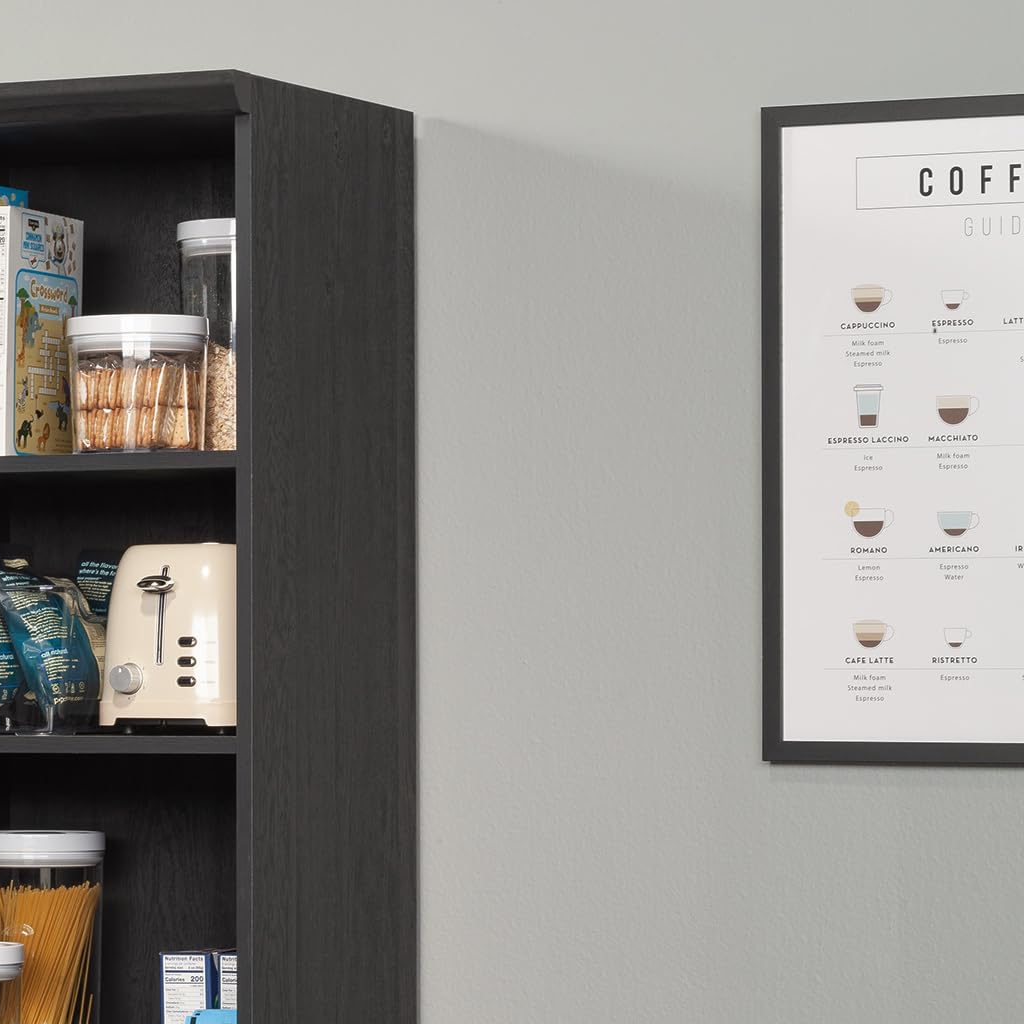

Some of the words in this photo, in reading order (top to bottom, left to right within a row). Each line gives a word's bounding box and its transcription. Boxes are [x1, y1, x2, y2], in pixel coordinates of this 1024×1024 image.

[918, 163, 1023, 198] COFF
[962, 215, 1022, 237] GUID
[30, 279, 68, 304] Crossword
[840, 321, 896, 331] CAPPUCCINO
[931, 318, 974, 328] ESPRESSO
[851, 339, 866, 347] Milk
[938, 337, 968, 346] Espresso
[845, 350, 875, 358] Steamed
[876, 349, 890, 357] milk
[853, 360, 883, 368] Espresso
[827, 436, 870, 445] ESPRESSO
[871, 435, 910, 444] LACCINO
[928, 434, 979, 443] MACCHIATO
[936, 452, 951, 460] Milk
[854, 464, 884, 473] Espresso
[938, 463, 969, 471] Espresso
[850, 546, 888, 555] ROMANO
[928, 545, 980, 554] AMERICANO
[939, 563, 969, 571] Espresso
[854, 574, 884, 582] Espresso
[944, 573, 964, 581] Water
[844, 656, 867, 664] CAFE
[868, 656, 894, 664] LATTE
[931, 656, 978, 664] RISTRETTO
[940, 674, 970, 682] Espresso
[847, 684, 877, 692] Steamed
[855, 695, 885, 703] Espresso
